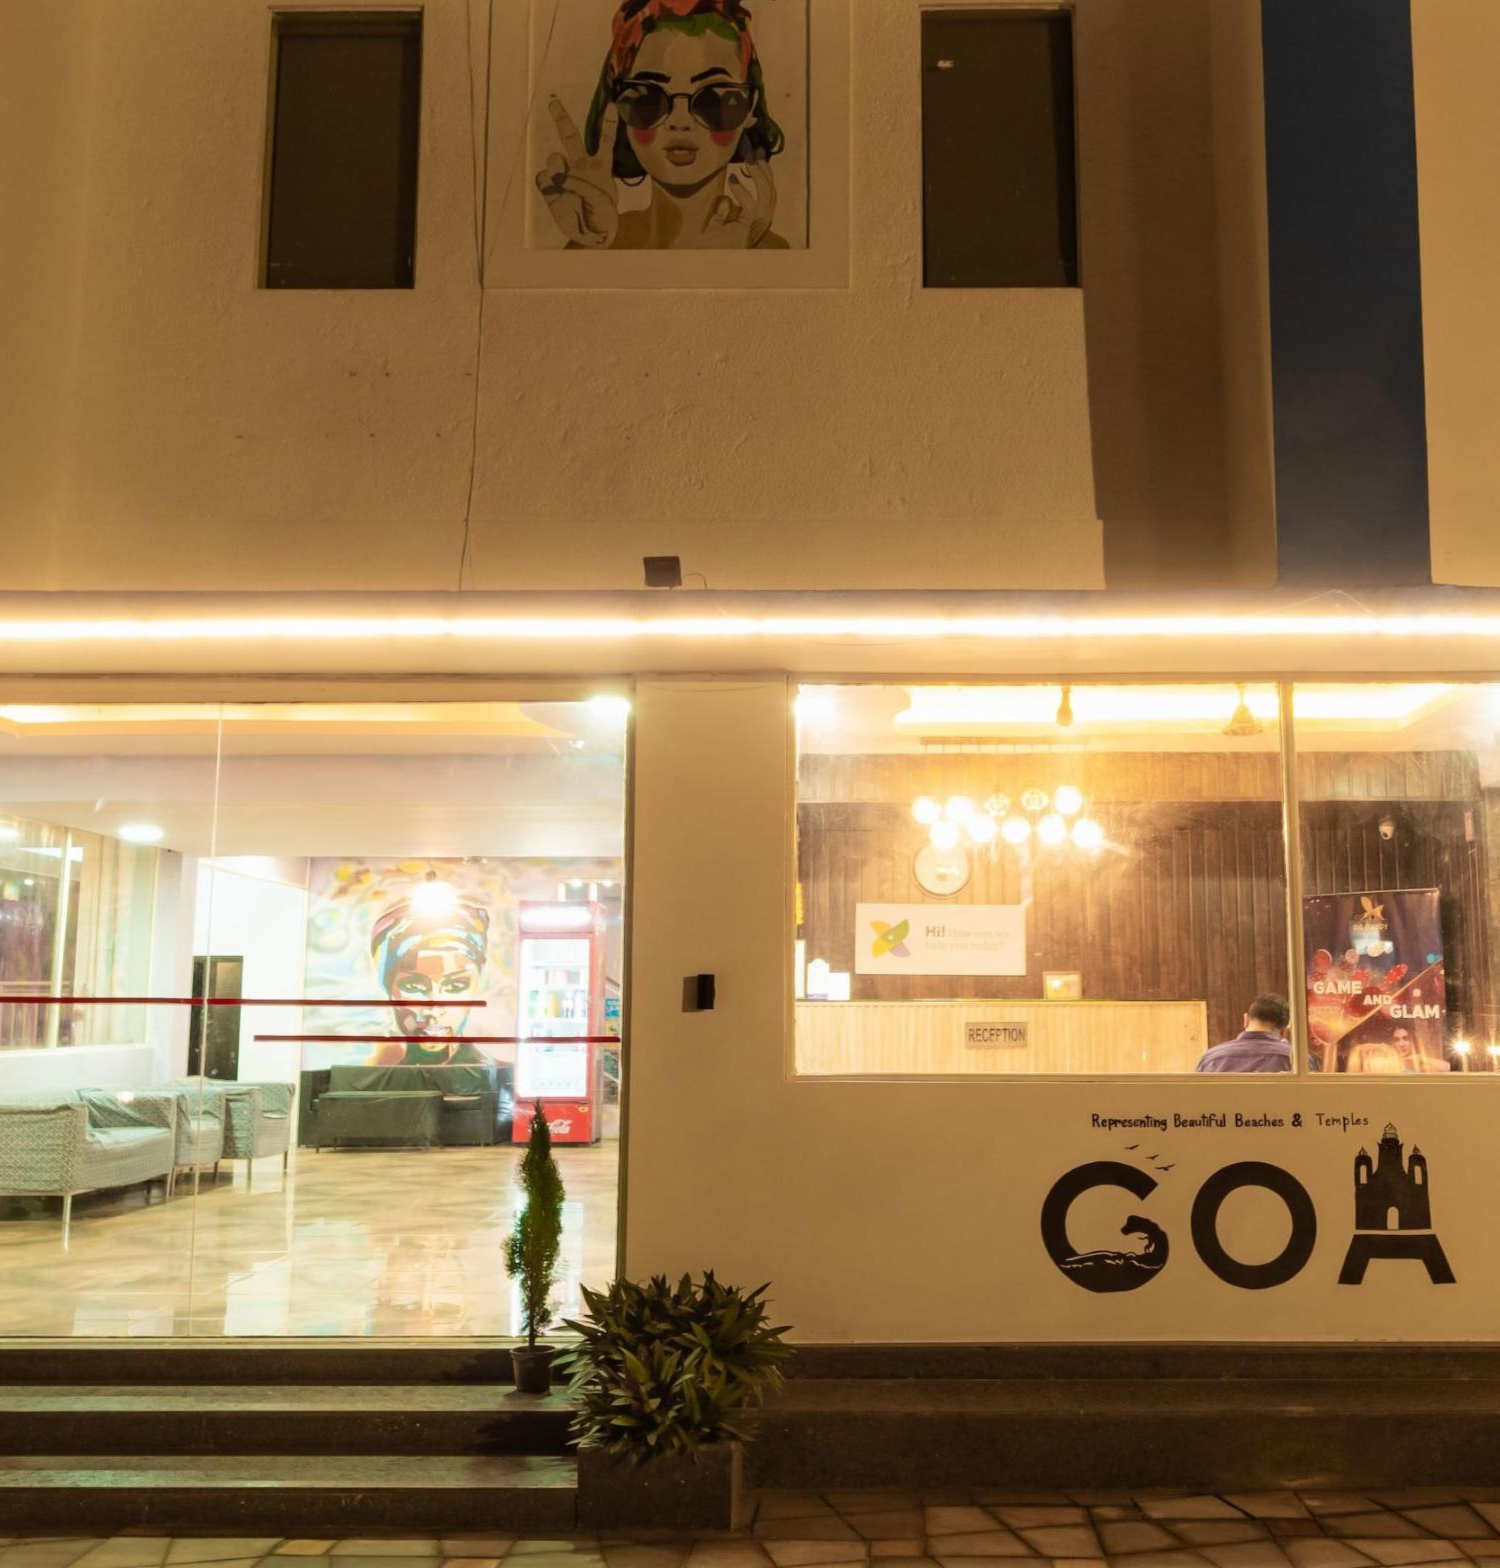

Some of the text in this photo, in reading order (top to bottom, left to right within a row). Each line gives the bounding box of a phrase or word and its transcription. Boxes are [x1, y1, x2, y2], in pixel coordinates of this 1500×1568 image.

[925, 925, 946, 937] Hi!
[1313, 981, 1362, 995] GAME
[1363, 994, 1392, 1006] AND
[1390, 1004, 1440, 1019] GLAM
[968, 1028, 1025, 1042] RECEPTION
[1091, 1113, 1369, 1132] Representing Beautiful Beaches & Temples
[1040, 1122, 1457, 1294] GOA
